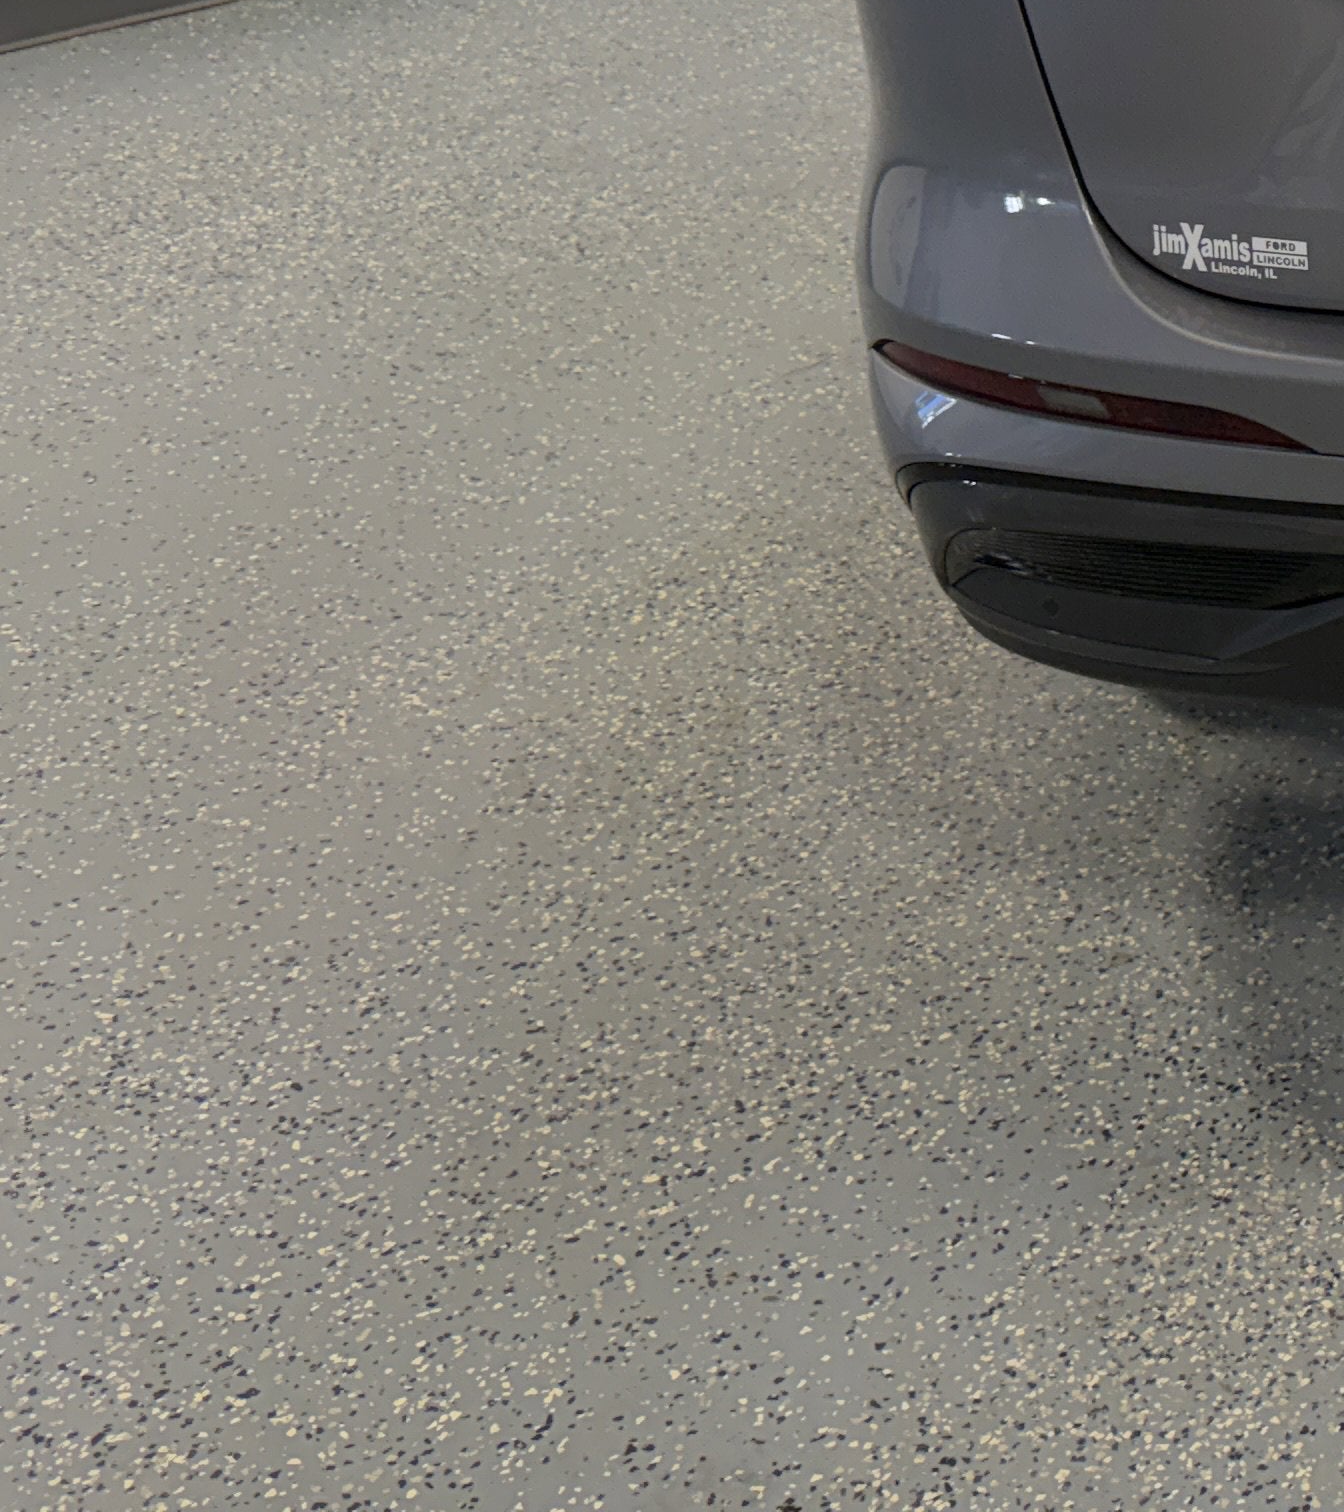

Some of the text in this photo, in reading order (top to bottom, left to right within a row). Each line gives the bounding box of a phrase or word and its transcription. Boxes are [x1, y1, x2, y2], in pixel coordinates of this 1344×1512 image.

[1265, 240, 1296, 252] FORD
[1256, 254, 1306, 268] LINCOLN
[1211, 261, 1278, 280] Lincoln, IL
